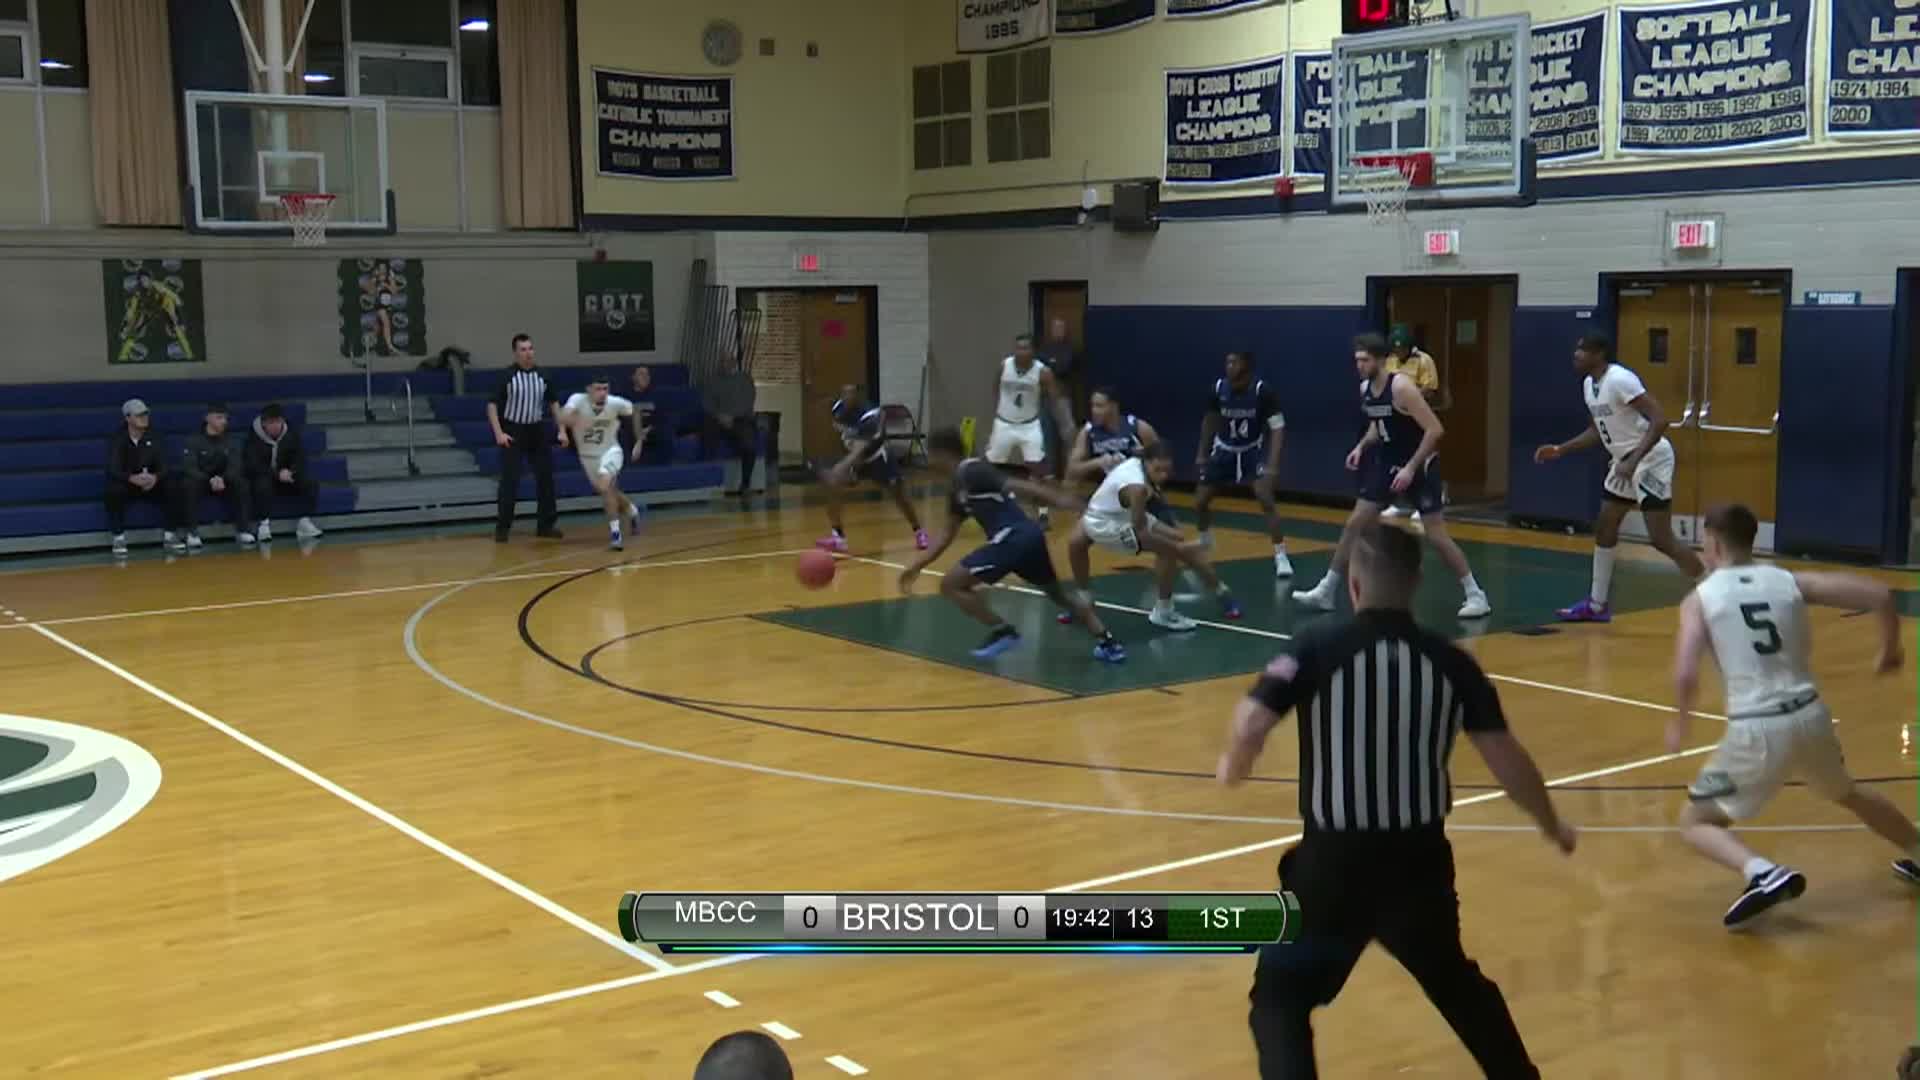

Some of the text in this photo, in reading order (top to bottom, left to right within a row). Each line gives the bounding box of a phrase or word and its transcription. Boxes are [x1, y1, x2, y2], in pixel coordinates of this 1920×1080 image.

[1635, 2, 1791, 41] SOFTBALL
[1870, 14, 1920, 42] LE
[1651, 32, 1772, 69] LEAGUE
[1633, 59, 1792, 97] CHAMPIONS
[1834, 80, 1909, 97] 1974 1984
[1186, 93, 1261, 119] LEAGUE
[1694, 100, 1725, 117] 1996
[1831, 107, 1868, 122] 2000
[609, 128, 721, 150] CHAMPIONS
[1175, 112, 1273, 141] CHAMPIONS
[1568, 131, 1597, 147] 2014
[1655, 123, 1688, 140] 2000
[1693, 121, 1724, 140] 2001
[1731, 118, 1763, 137] 2002
[1769, 113, 1802, 131] 2003
[1679, 223, 1702, 246] EXIT
[583, 428, 605, 445] 23
[1740, 602, 1783, 656] 5
